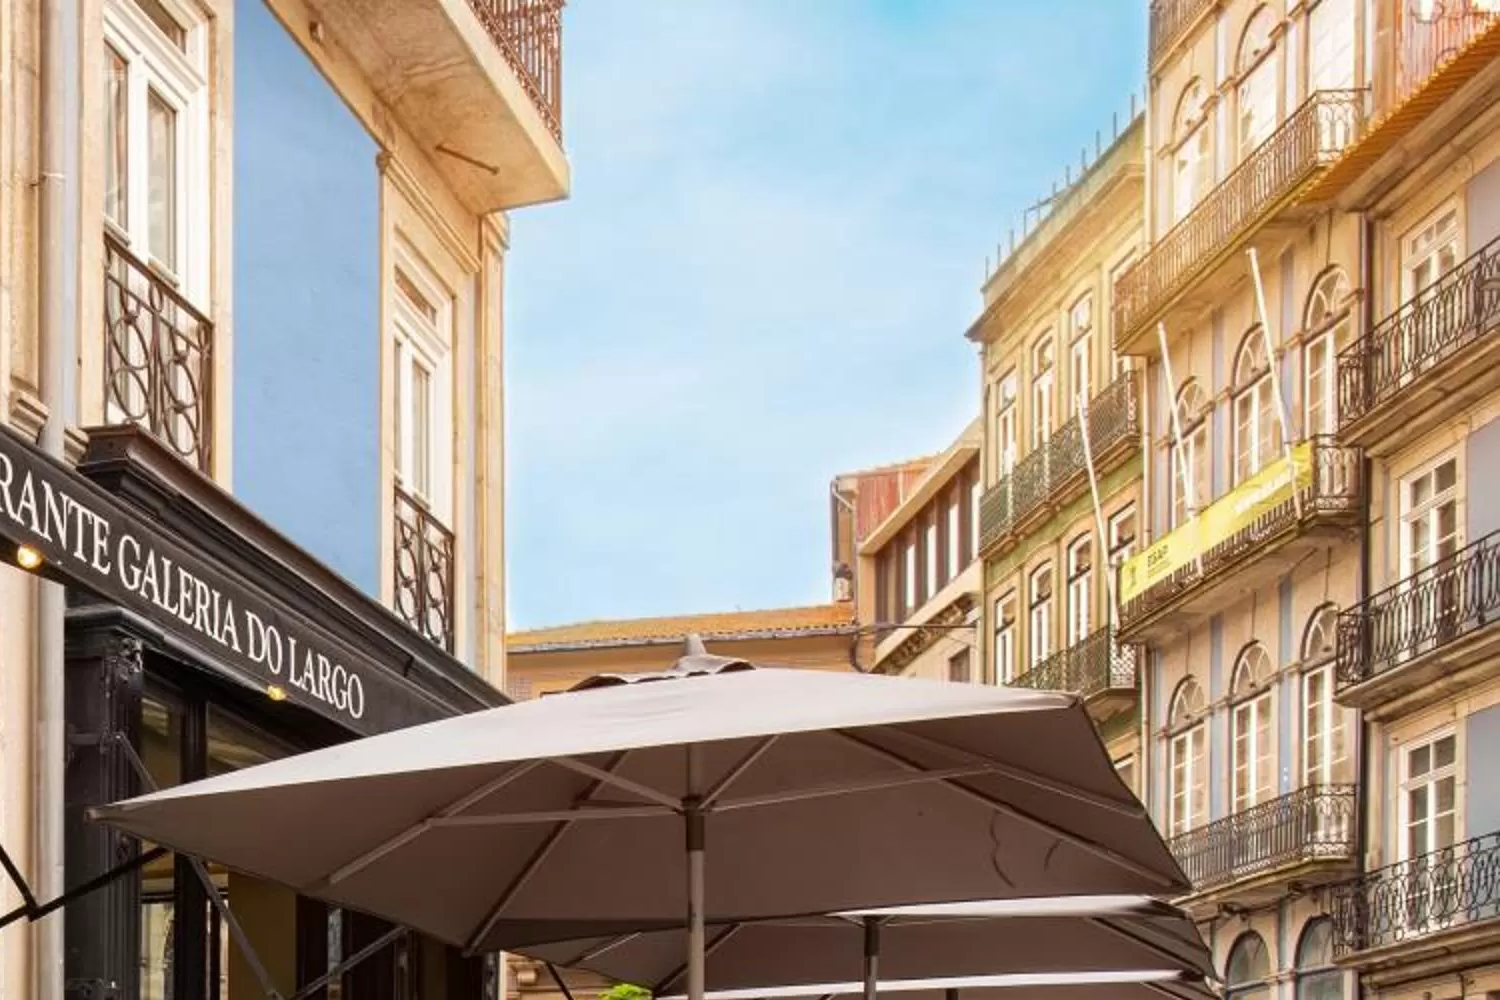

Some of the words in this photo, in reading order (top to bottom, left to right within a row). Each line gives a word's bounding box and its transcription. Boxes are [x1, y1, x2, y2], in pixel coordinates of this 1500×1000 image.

[118, 534, 242, 654] GALERIA
[245, 610, 283, 674] DO
[288, 635, 365, 720] LARGO
